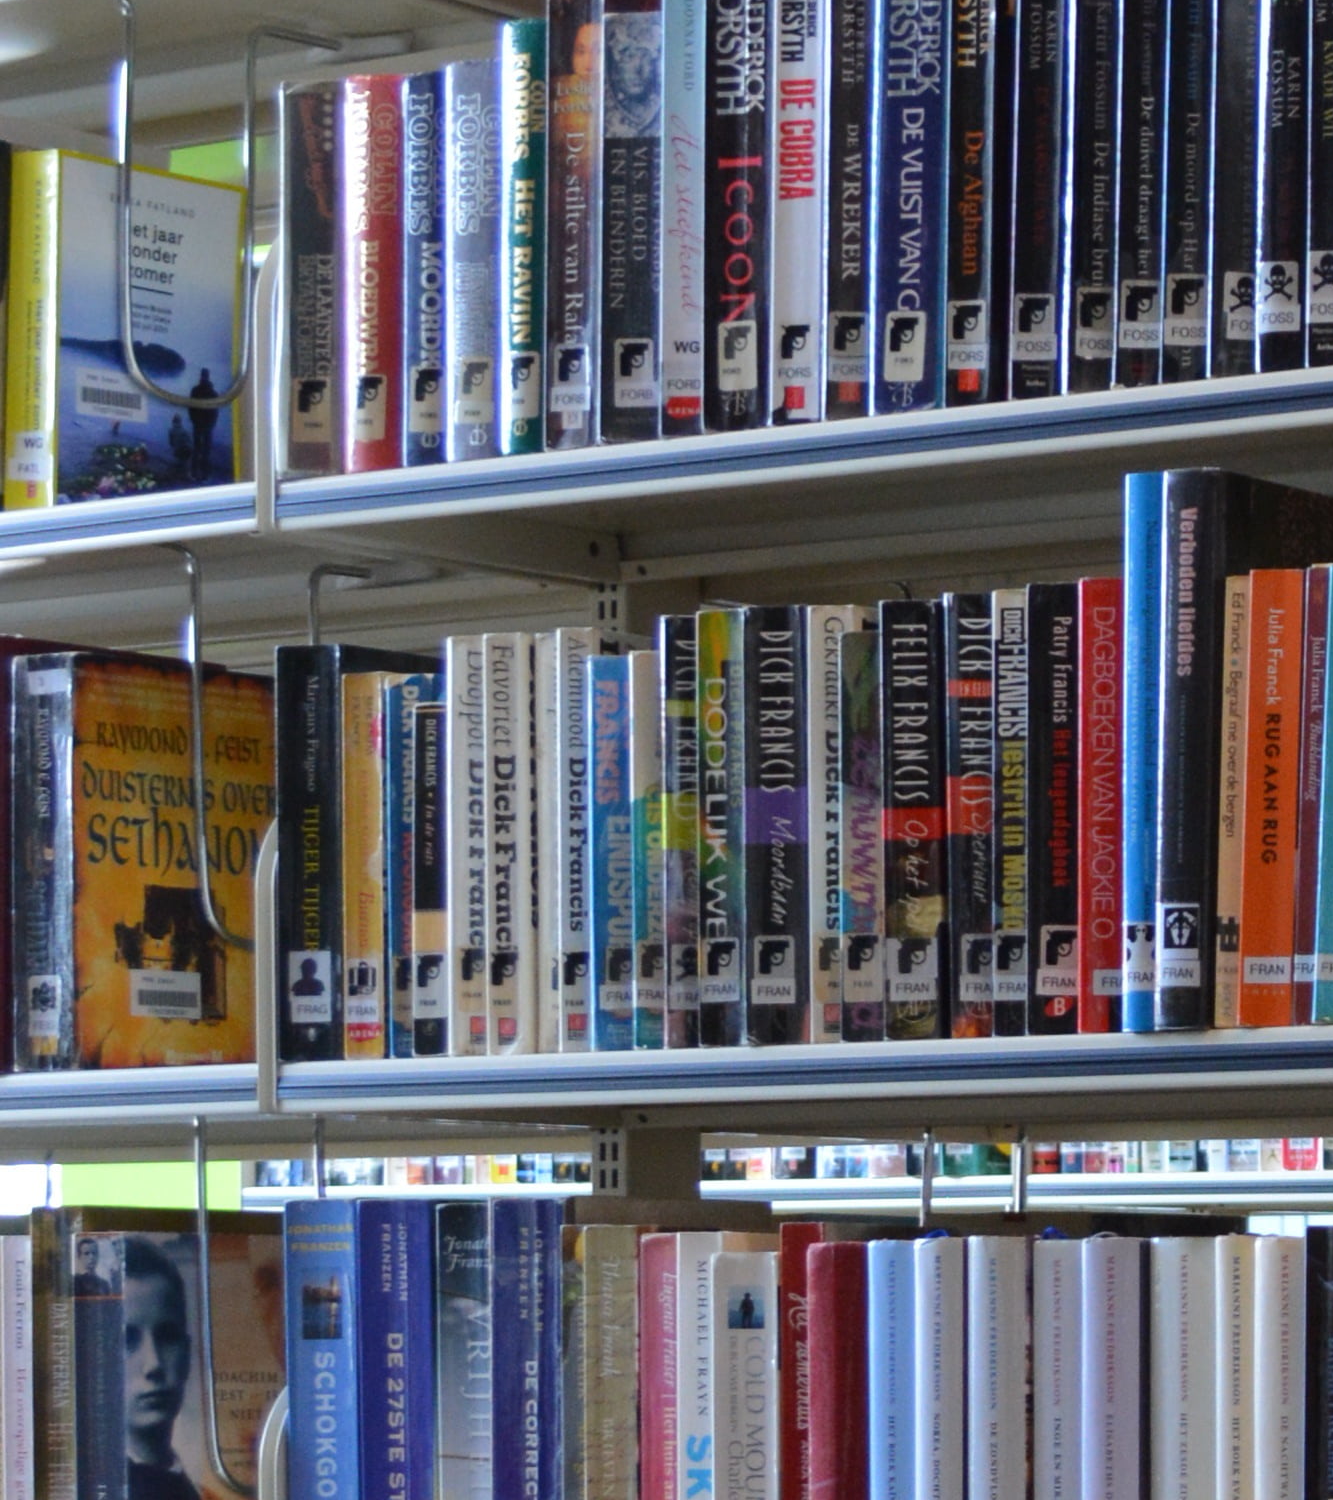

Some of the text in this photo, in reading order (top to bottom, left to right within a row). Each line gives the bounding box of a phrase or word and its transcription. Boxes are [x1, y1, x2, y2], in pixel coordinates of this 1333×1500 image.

[778, 79, 816, 201] DE COBRA
[962, 131, 984, 276] De Afghaan
[512, 179, 534, 343] HET RAVIJN
[951, 350, 983, 363] FORS
[1177, 507, 1198, 676] Verboden liefdes
[759, 631, 796, 794] DICK FRANCIS
[893, 624, 929, 812] FELIX FRANCIS
[1092, 607, 1116, 910] DAGBOEKEN VAN JACKIE
[1260, 609, 1284, 864] Julia Franck RUG AAN RUG
[757, 985, 791, 997] FRAN
[387, 1333, 403, 1369] DE
[388, 1377, 405, 1463] 27STE
